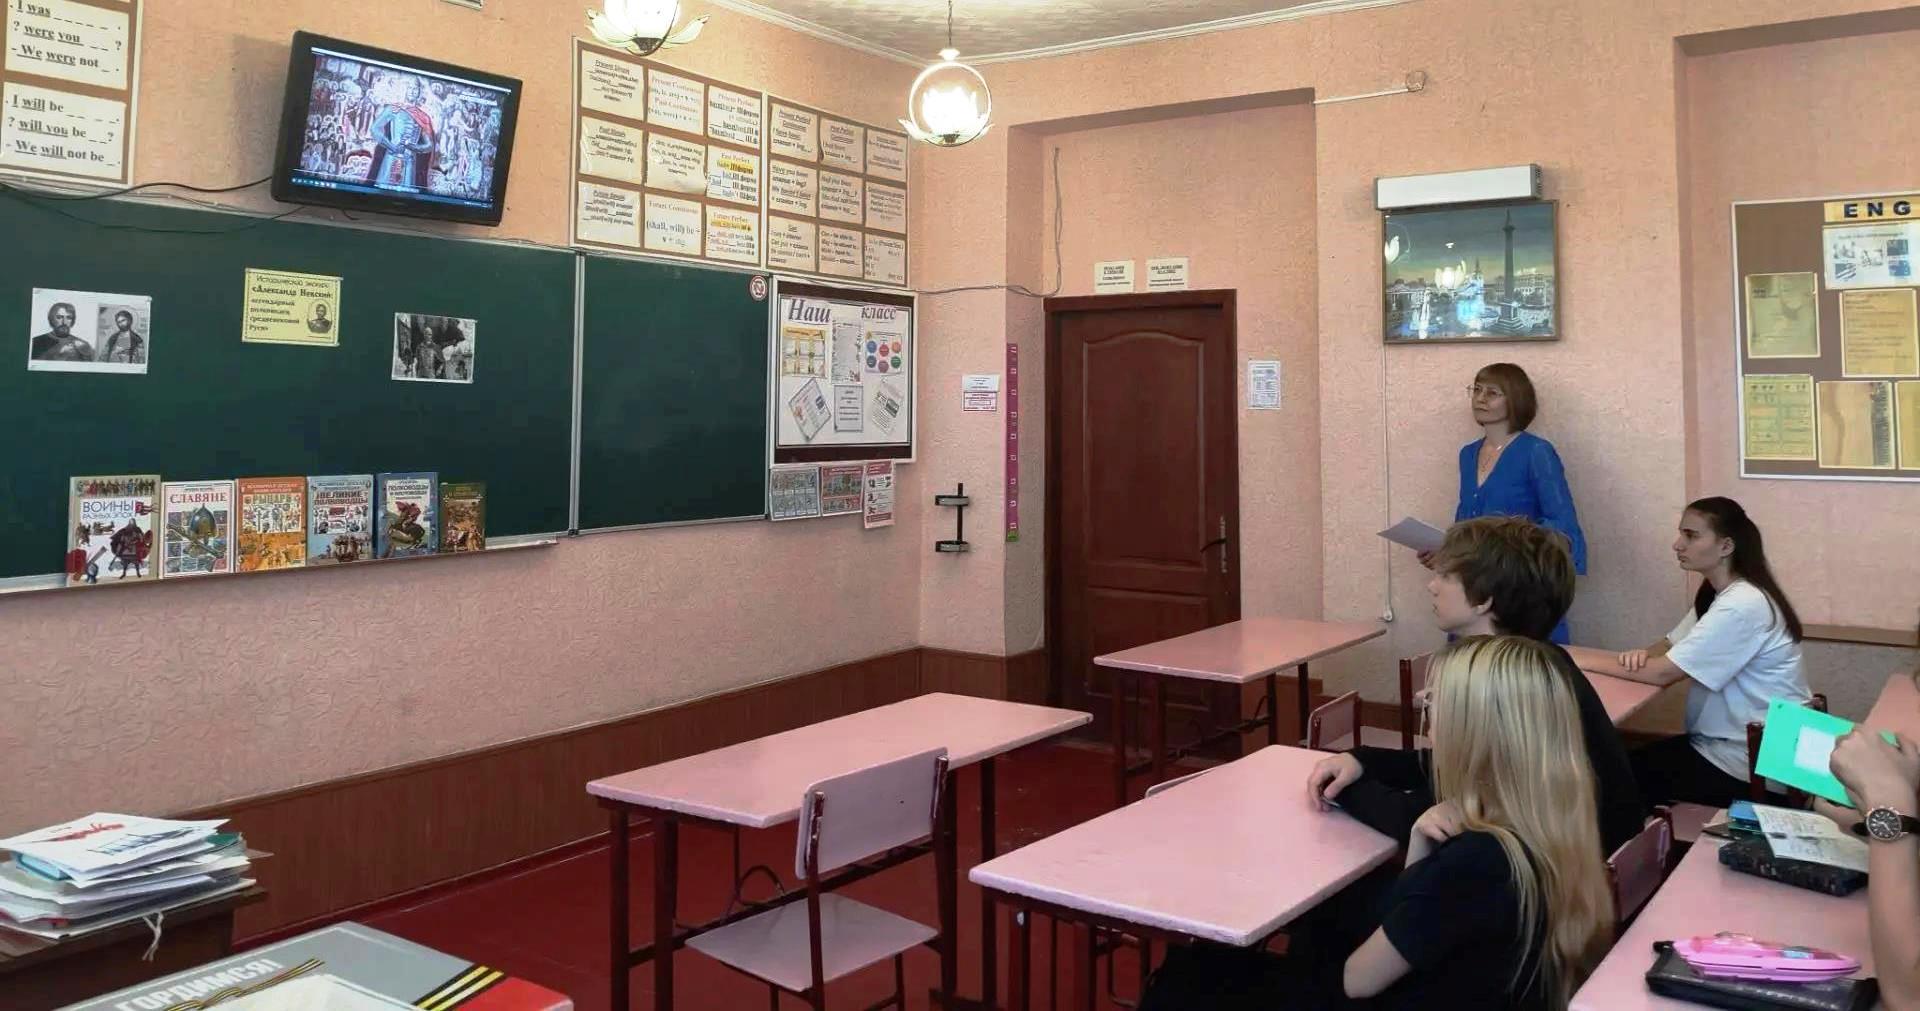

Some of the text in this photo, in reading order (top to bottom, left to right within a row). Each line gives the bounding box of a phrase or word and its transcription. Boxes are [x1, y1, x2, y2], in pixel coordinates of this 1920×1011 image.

[26, 3, 51, 17] was
[23, 25, 55, 40] were
[57, 31, 82, 46] you
[16, 44, 99, 67] We were not
[12, 94, 64, 112] I will be
[18, 119, 43, 133] will
[46, 124, 69, 137] you
[72, 126, 87, 138] be
[15, 140, 104, 162] We will not be
[788, 298, 897, 323] Наш класс
[82, 499, 134, 514] ВОИНЫ
[169, 491, 228, 504] СЛАВЯНЕ
[115, 958, 285, 1011] ГОРДИМСЯ!
